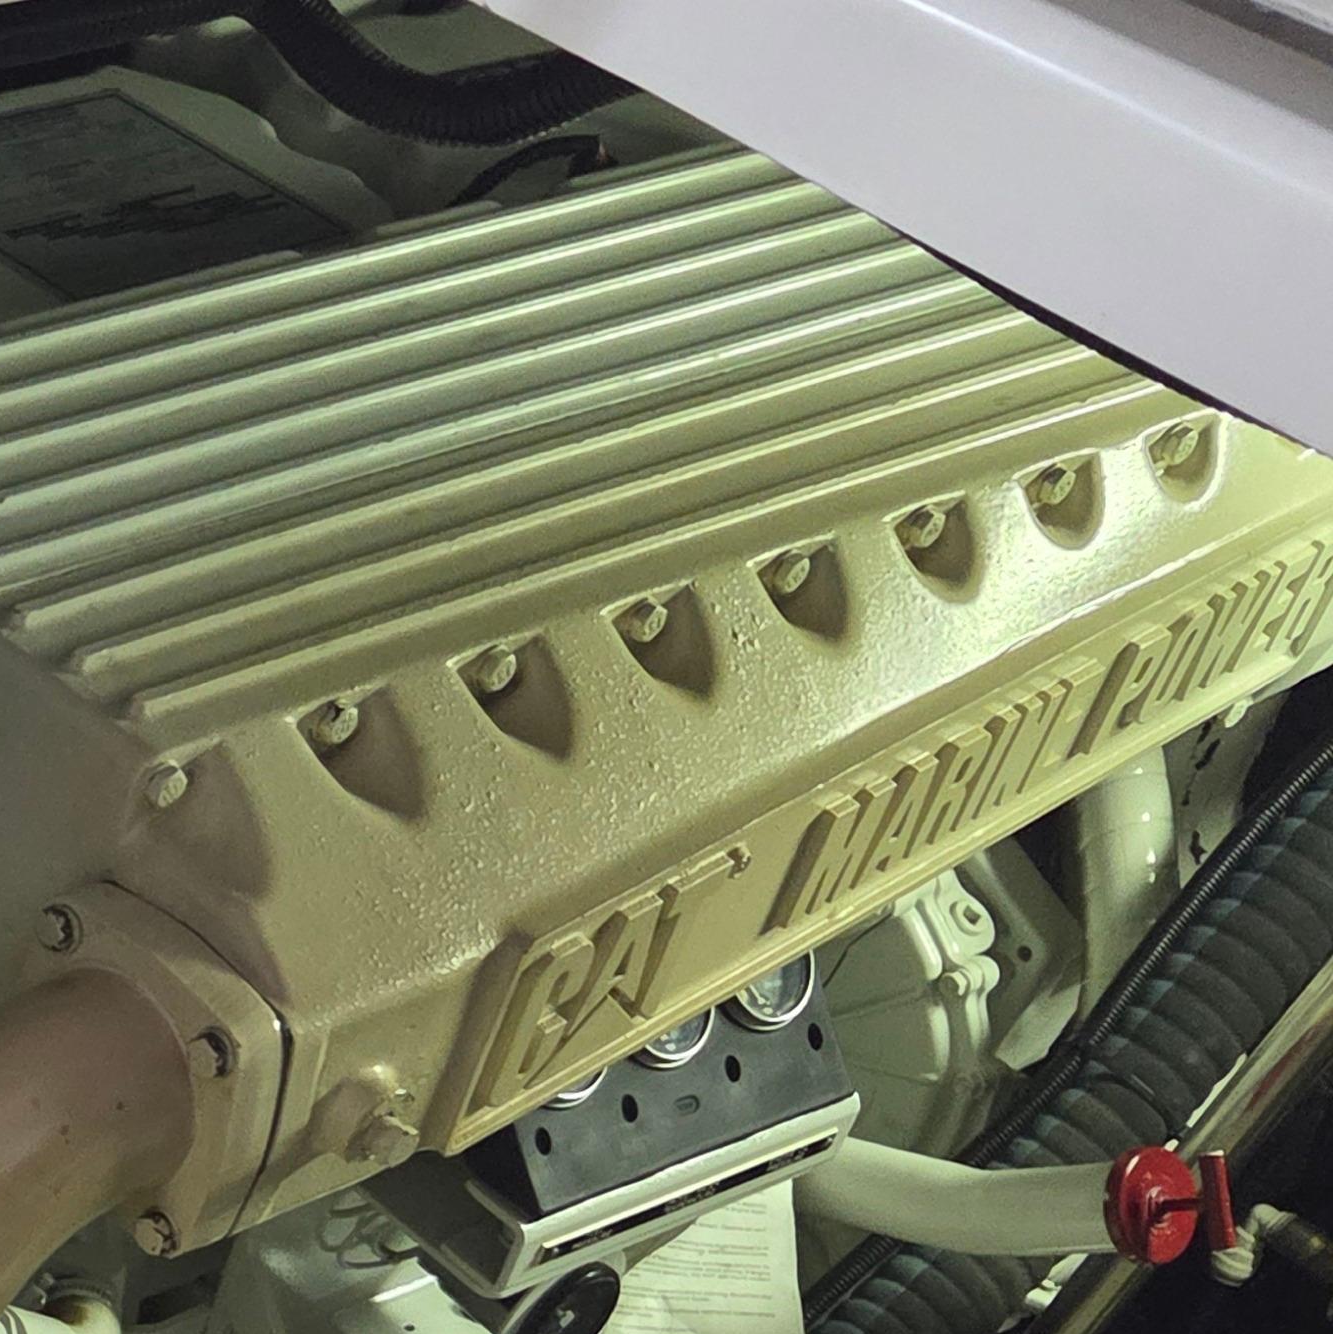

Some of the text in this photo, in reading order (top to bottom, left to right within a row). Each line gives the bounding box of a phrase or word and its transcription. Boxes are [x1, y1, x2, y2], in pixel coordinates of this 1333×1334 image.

[477, 530, 1333, 1107] CAT MARINE POWER
